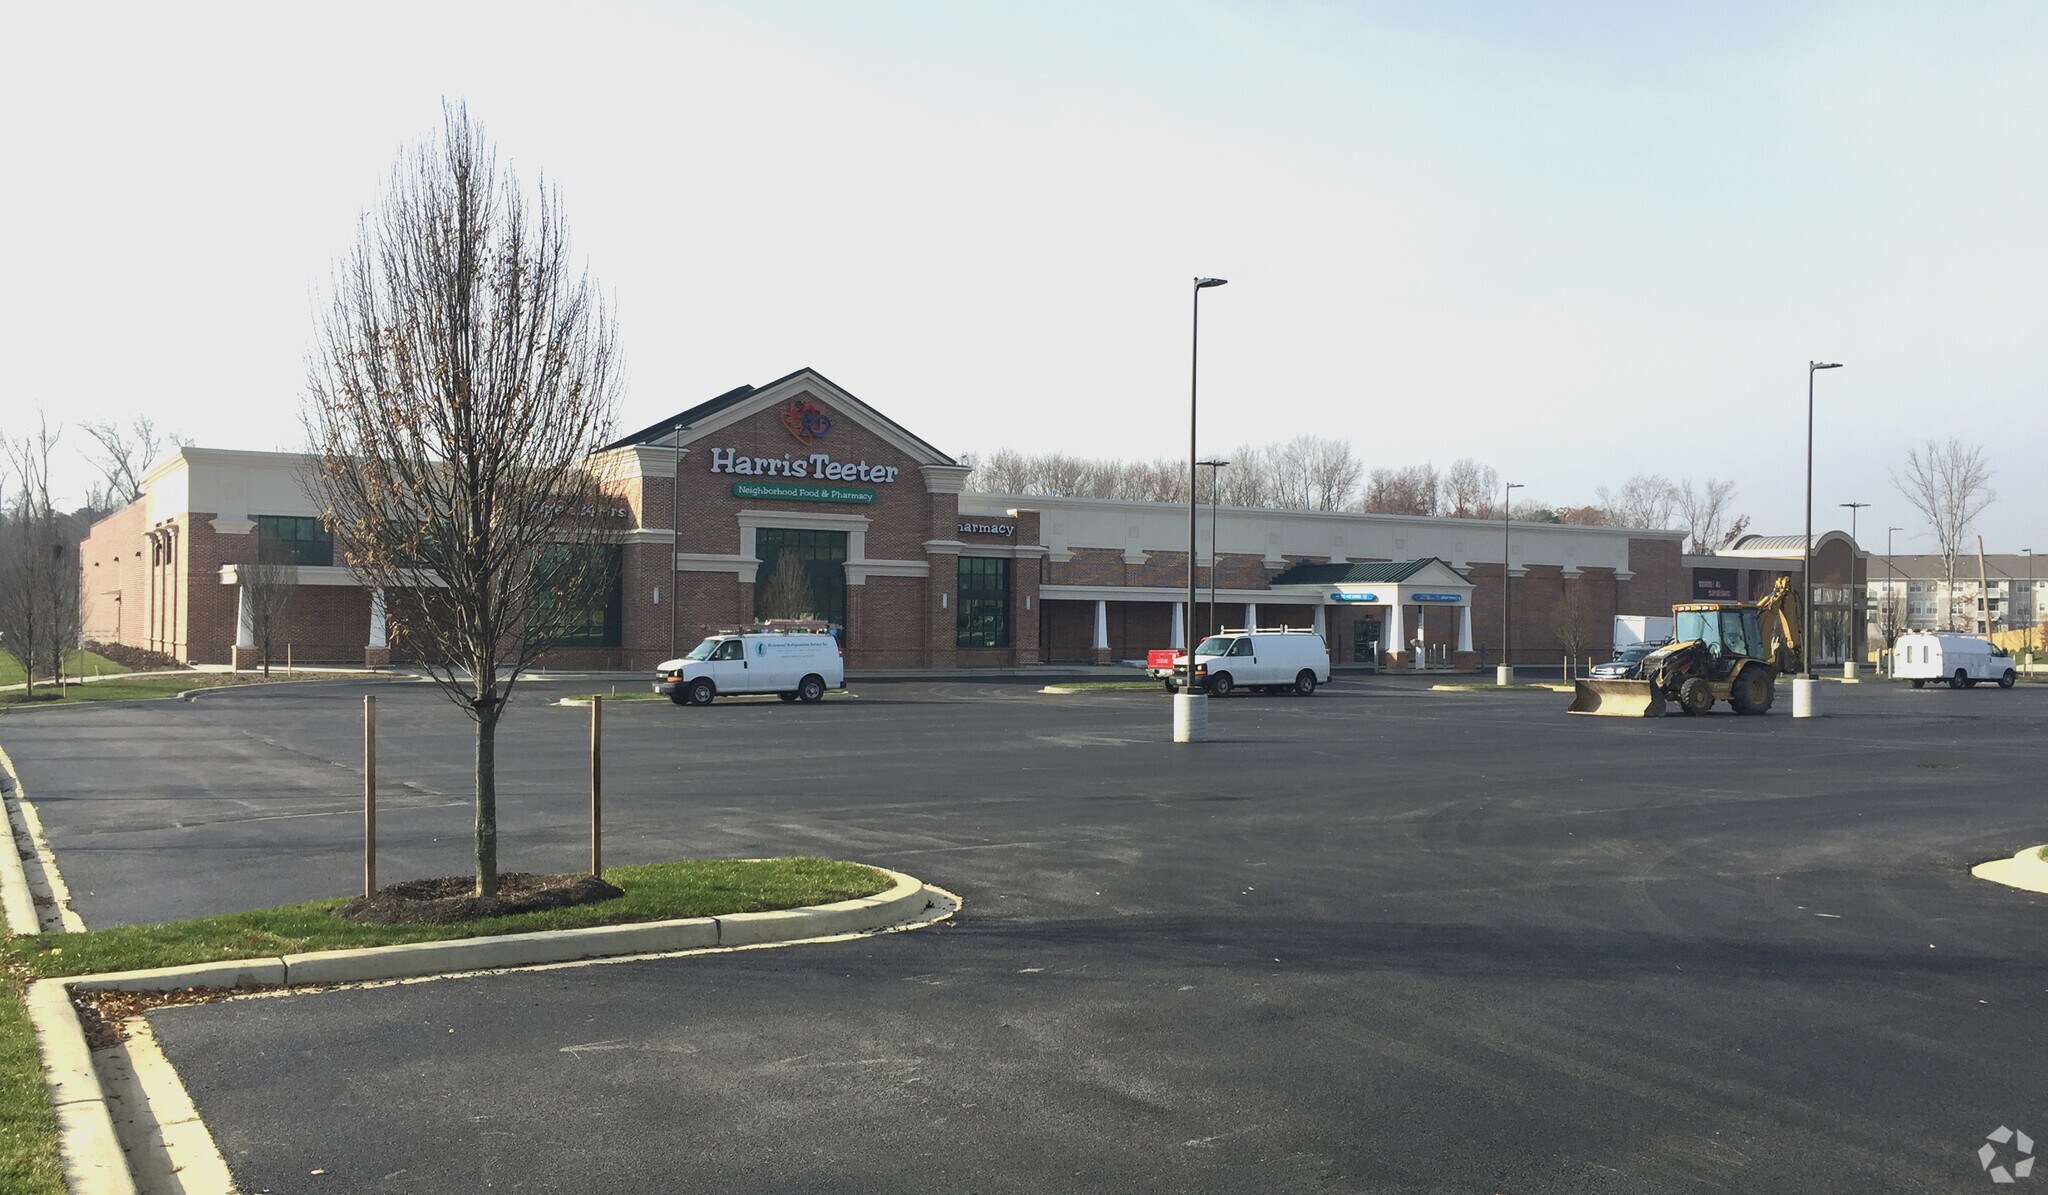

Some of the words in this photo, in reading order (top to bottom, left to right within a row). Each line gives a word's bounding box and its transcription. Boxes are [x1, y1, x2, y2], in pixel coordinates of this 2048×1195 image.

[738, 485, 798, 498] Neighborhood
[799, 489, 820, 498] Food
[821, 489, 829, 498] &
[831, 490, 873, 502] Pharmacy
